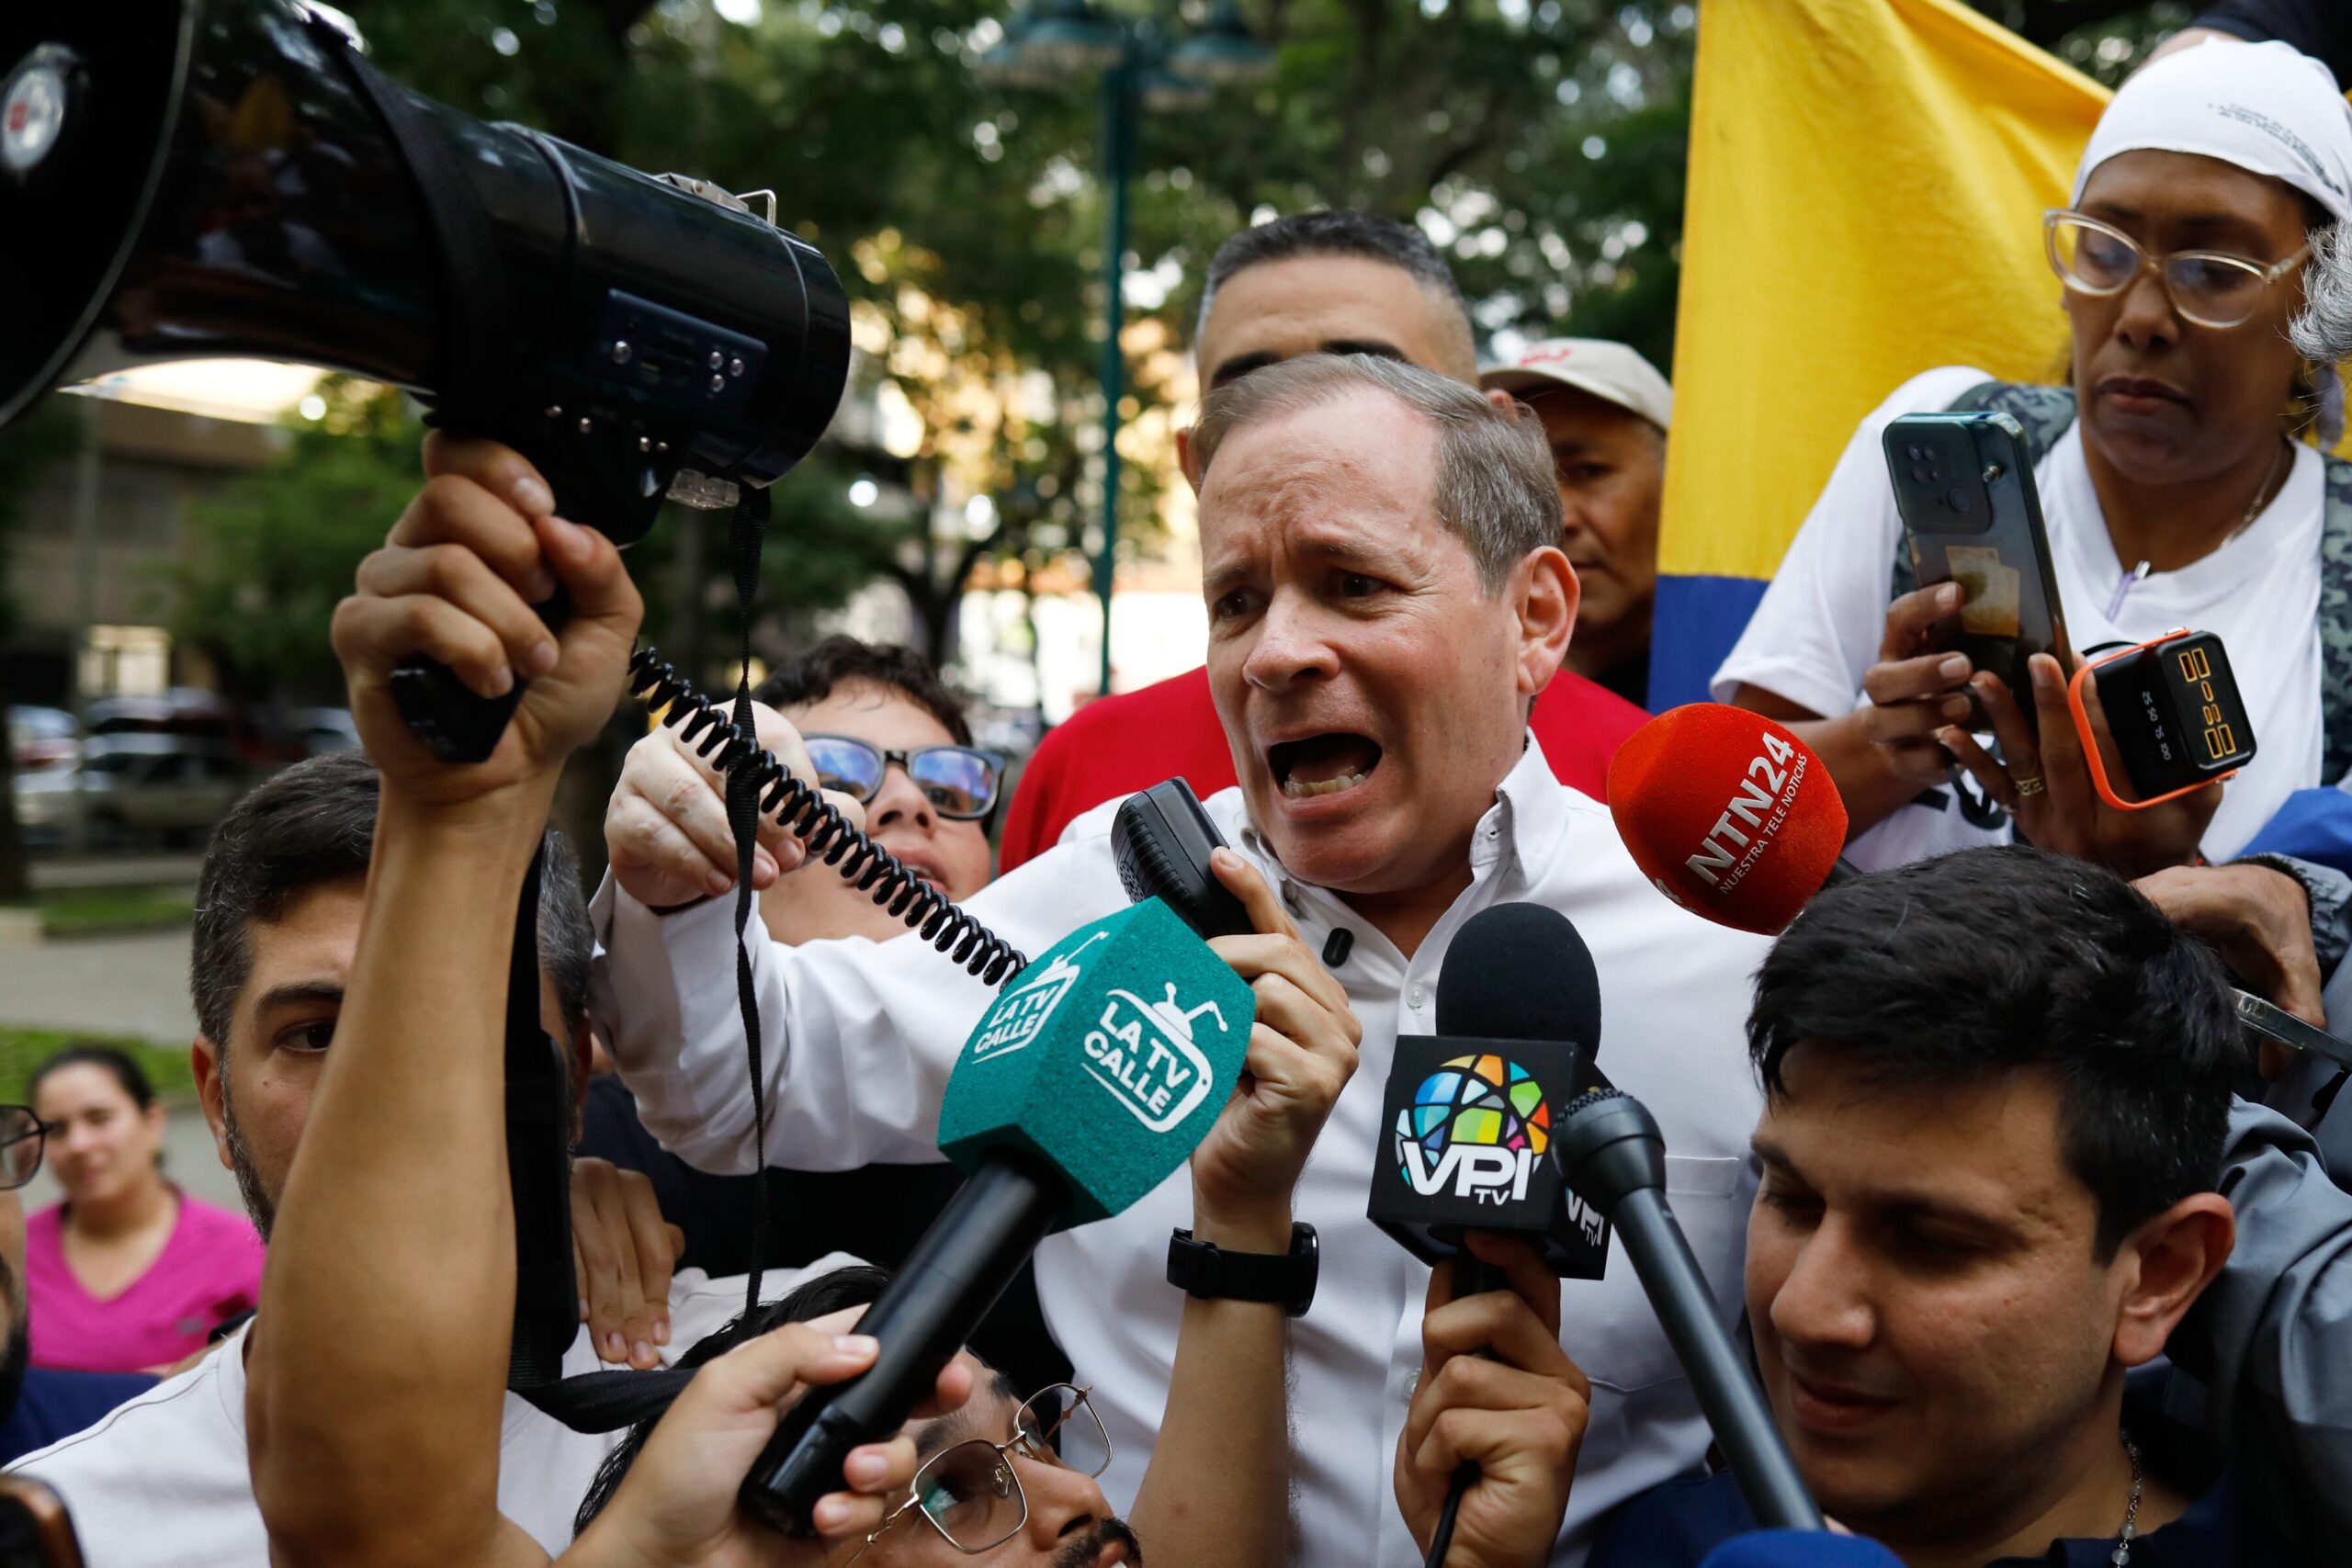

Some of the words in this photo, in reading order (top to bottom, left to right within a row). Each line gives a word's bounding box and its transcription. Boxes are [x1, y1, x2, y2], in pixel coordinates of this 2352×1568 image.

[1685, 731, 1794, 886] NTN24
[1719, 839, 1769, 895] NUESTRA
[1763, 807, 1787, 837] TELE
[1781, 753, 1807, 806] NOTICIAS
[974, 1013, 1039, 1054] CALLE
[988, 999, 1020, 1029] LA
[1020, 986, 1058, 1016] TV
[1084, 1031, 1171, 1115] CALLE
[1100, 1001, 1142, 1055] LA
[1147, 1038, 1191, 1089] TV
[1402, 1141, 1532, 1201] VPI
[1474, 1189, 1510, 1205] TV
[1586, 1225, 1597, 1247] TV
